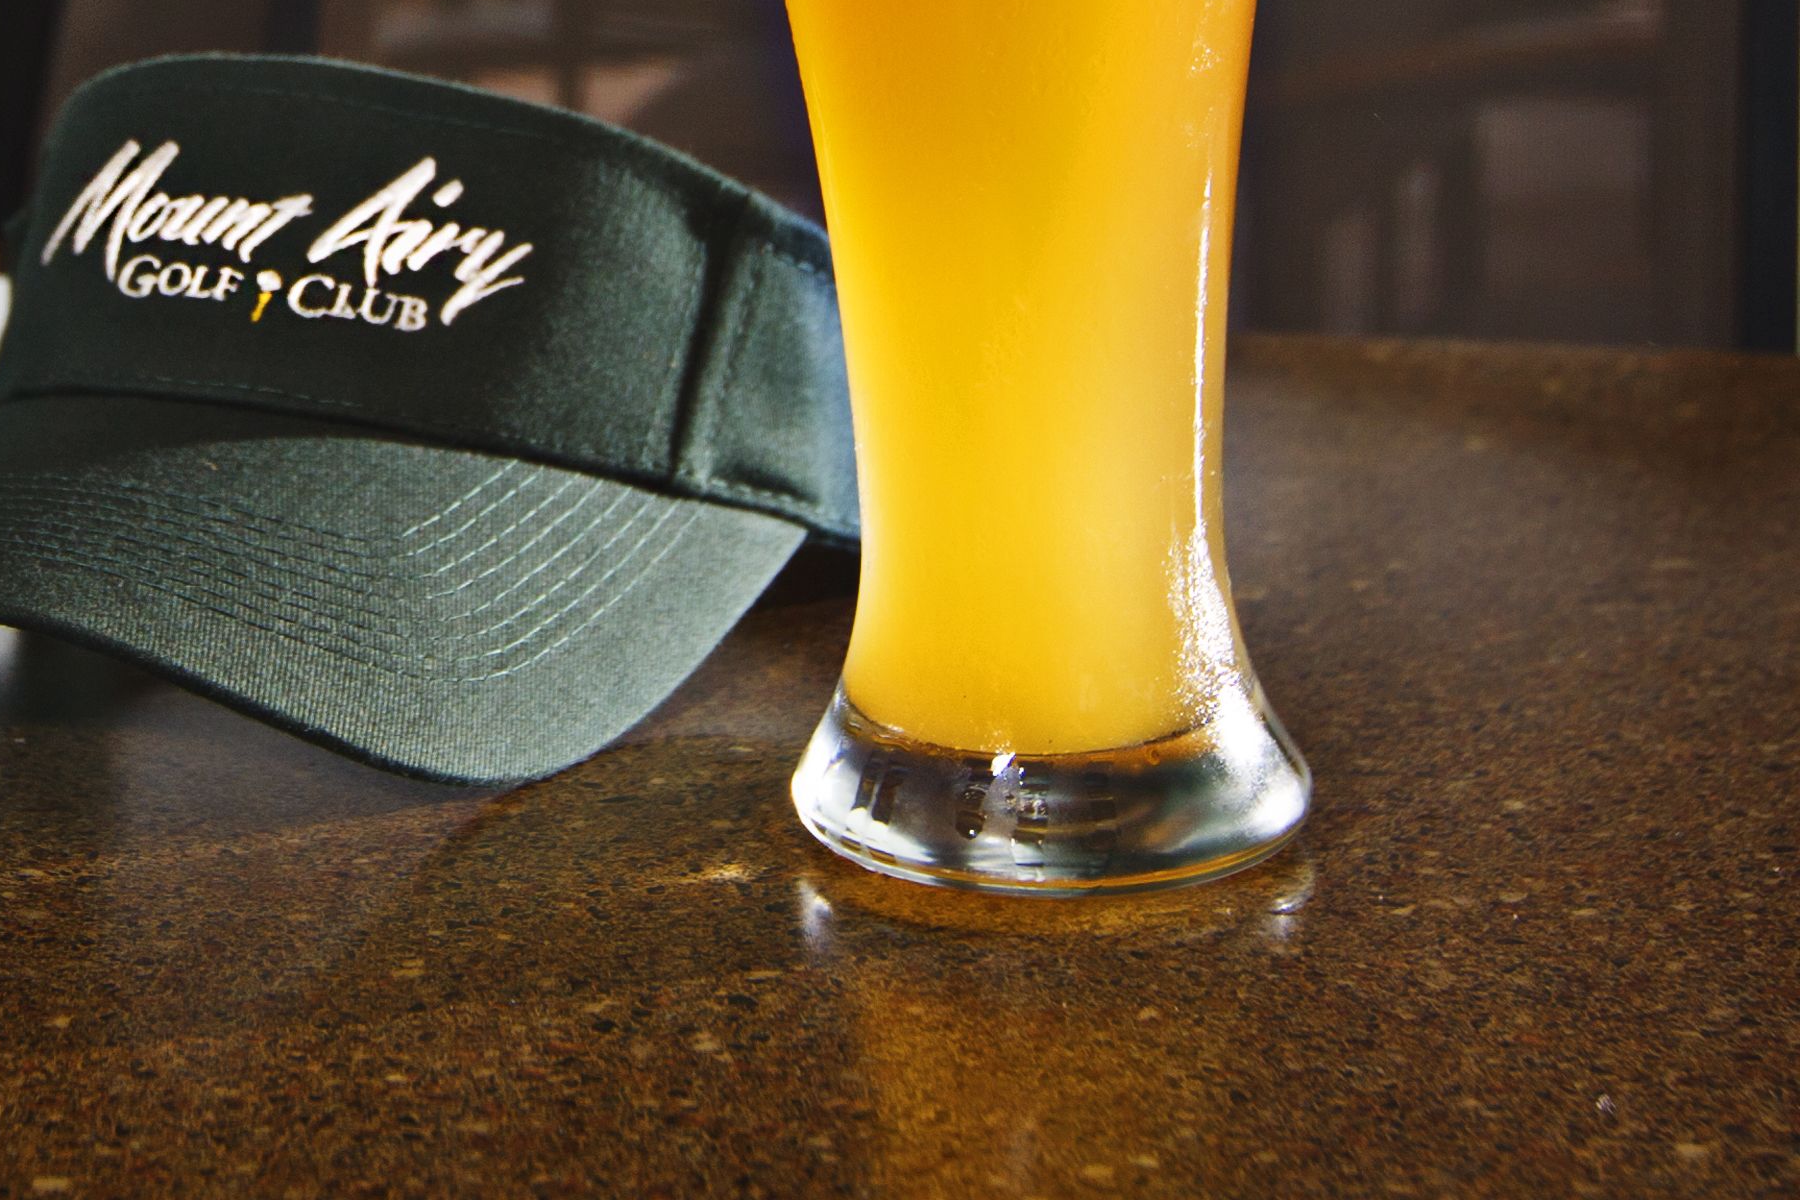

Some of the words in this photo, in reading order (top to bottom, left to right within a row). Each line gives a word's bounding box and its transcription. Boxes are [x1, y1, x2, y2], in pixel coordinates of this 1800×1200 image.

[41, 139, 313, 282] Mount
[306, 156, 534, 327] Airy
[117, 254, 245, 302] GOLF
[286, 273, 429, 333] CLUB
